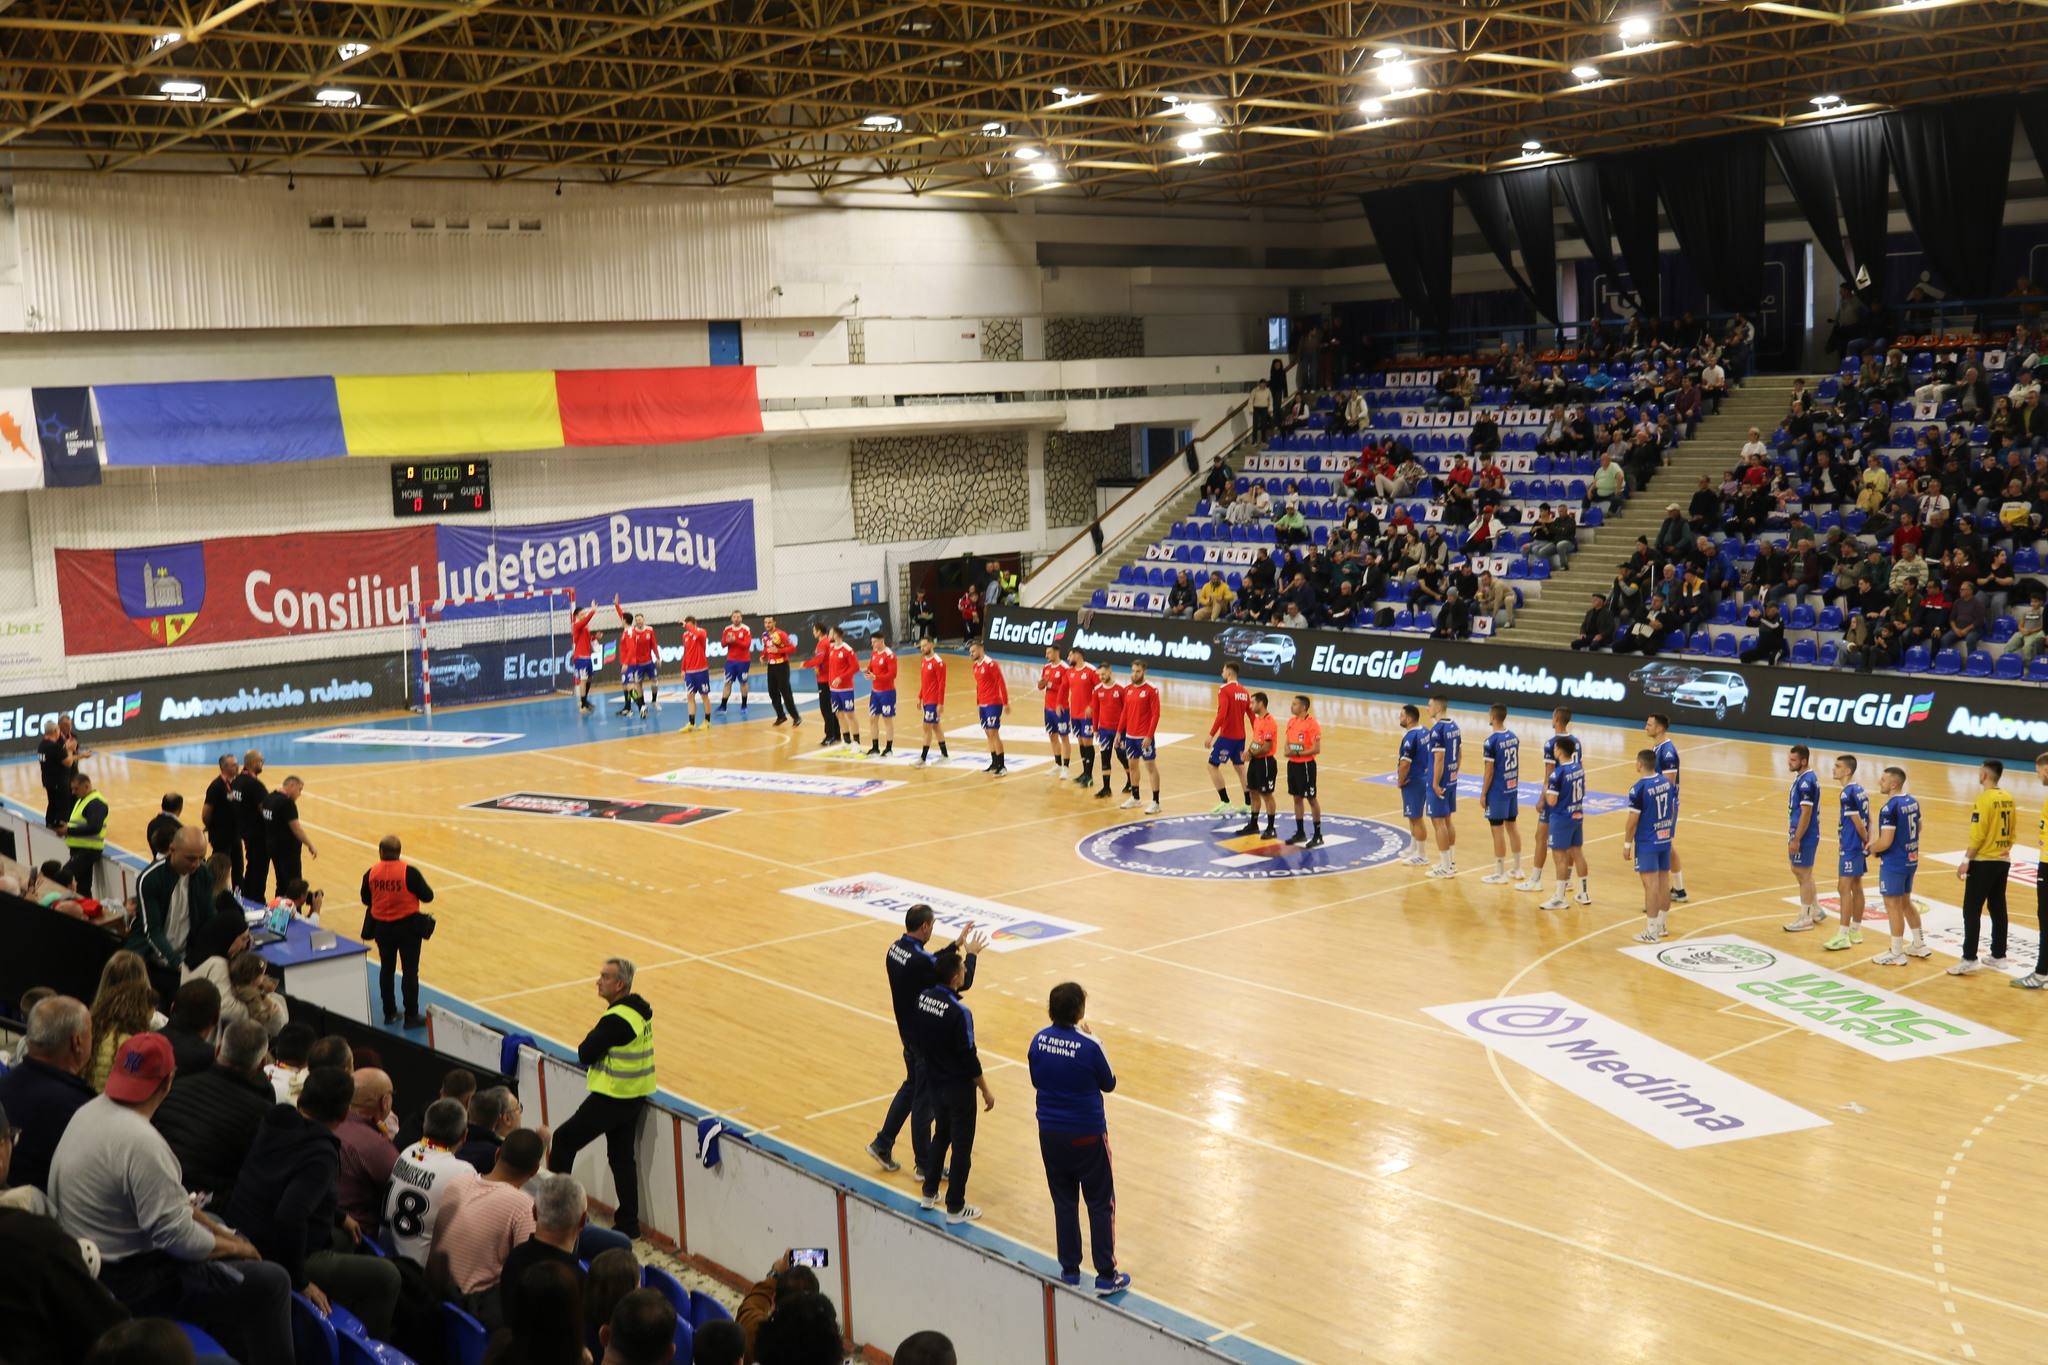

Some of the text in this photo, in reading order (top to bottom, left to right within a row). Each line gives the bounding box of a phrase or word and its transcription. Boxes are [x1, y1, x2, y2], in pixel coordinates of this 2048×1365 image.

[424, 467, 459, 481] 00:00
[401, 488, 423, 500] HOME
[460, 486, 484, 497] GUEST
[474, 495, 483, 508] 0
[414, 498, 422, 512] 0
[245, 565, 420, 631] Consiliul
[608, 515, 717, 573] Buzău
[990, 616, 1057, 646] ElcarGid
[1073, 628, 1163, 655] Autovehicule
[1165, 636, 1212, 661] rulate
[1311, 645, 1408, 680] ElcarGid
[1431, 660, 1557, 695] Autovehicule
[1561, 670, 1626, 702] rulate
[1771, 685, 1914, 729] ElcarGid
[160, 684, 304, 721] Autovehicule
[311, 678, 373, 703] rulate
[1504, 747, 1518, 771] 23
[1655, 792, 1668, 820] 17
[1908, 813, 1917, 840] 15
[1119, 861, 1201, 878] SPORT
[1202, 862, 1347, 879] NATIONAL
[374, 880, 402, 892] PRESS
[1736, 981, 1914, 1047] GUARD
[1776, 973, 1971, 1042] WMC
[1038, 1042, 1076, 1059] ТРЕБИЊЕ
[1048, 1036, 1082, 1050] ЛЕОТАР
[1546, 1039, 1746, 1132] Medima
